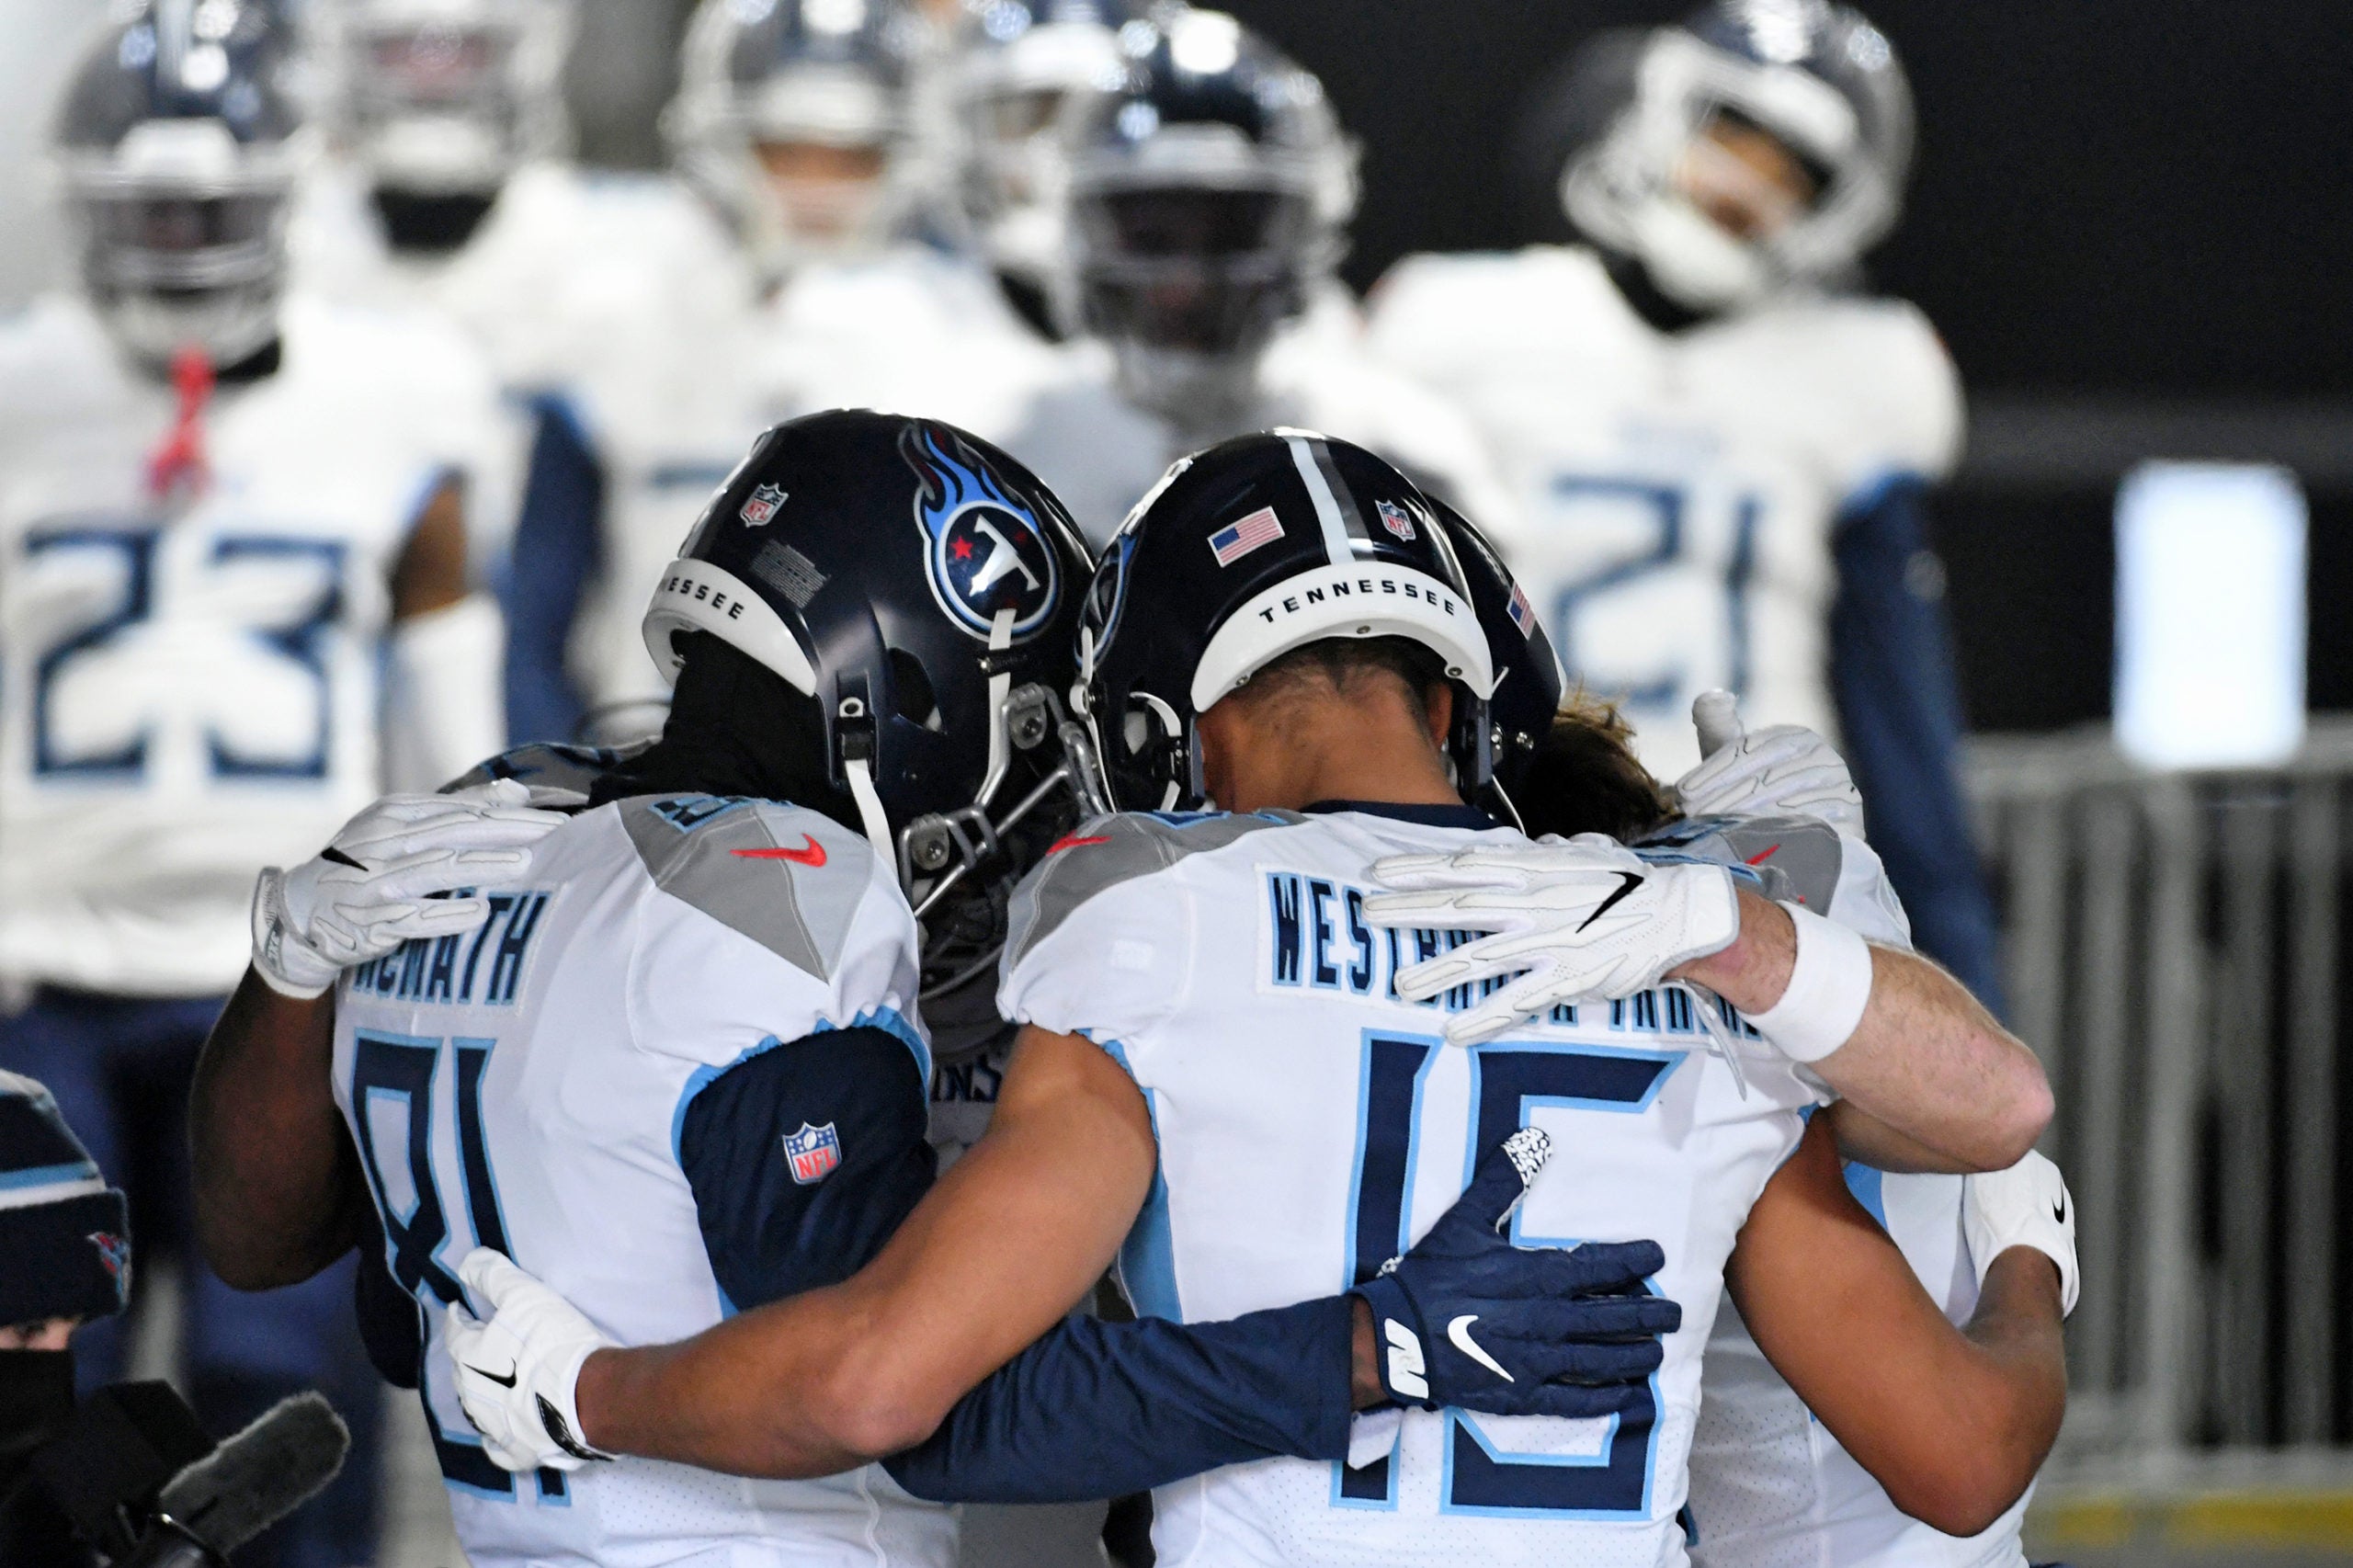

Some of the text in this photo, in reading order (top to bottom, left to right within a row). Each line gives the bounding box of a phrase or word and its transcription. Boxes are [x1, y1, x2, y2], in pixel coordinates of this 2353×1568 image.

[1387, 514, 1413, 535] NFL
[668, 577, 745, 619] ESSEE
[1259, 579, 1455, 623] TENNESSEE
[20, 524, 349, 781] 23
[795, 1148, 837, 1180] NFL
[1329, 1027, 1689, 1522] 15
